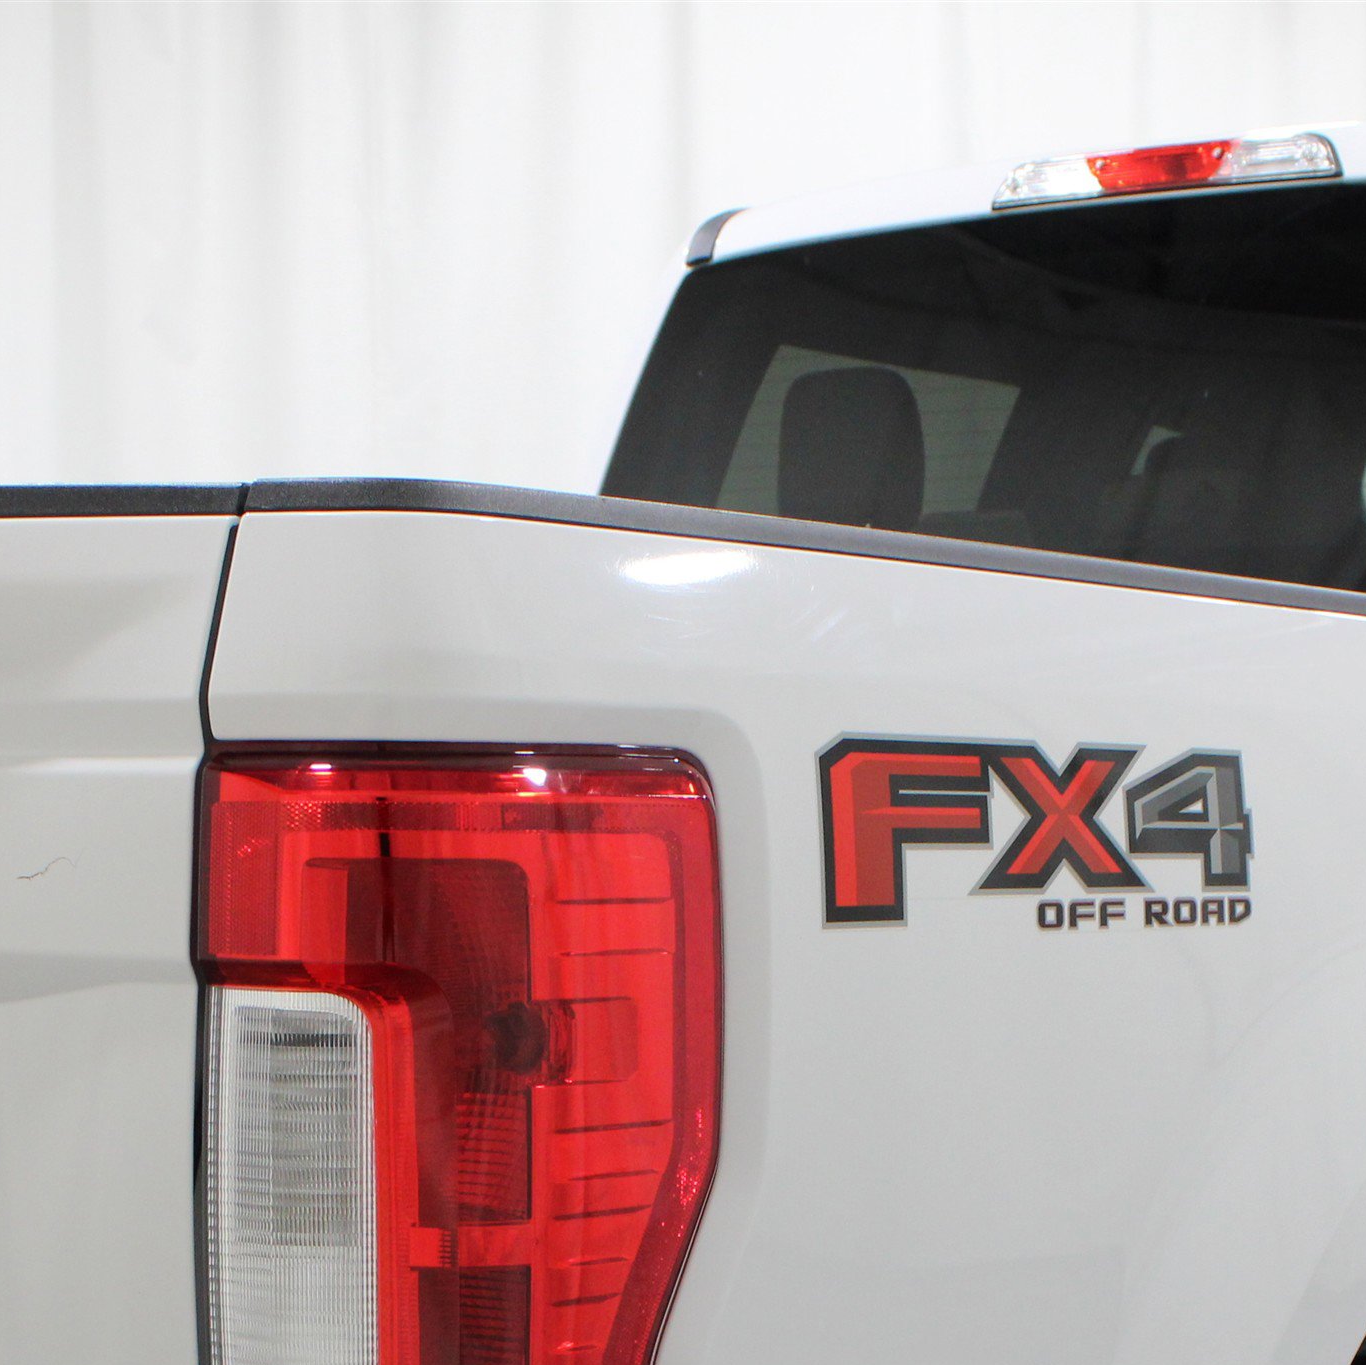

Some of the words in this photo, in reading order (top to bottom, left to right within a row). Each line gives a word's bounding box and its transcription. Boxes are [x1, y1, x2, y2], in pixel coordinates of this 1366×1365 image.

[815, 731, 1254, 929] FX4
[1037, 898, 1126, 929] OFF
[1144, 896, 1252, 927] ROAD
